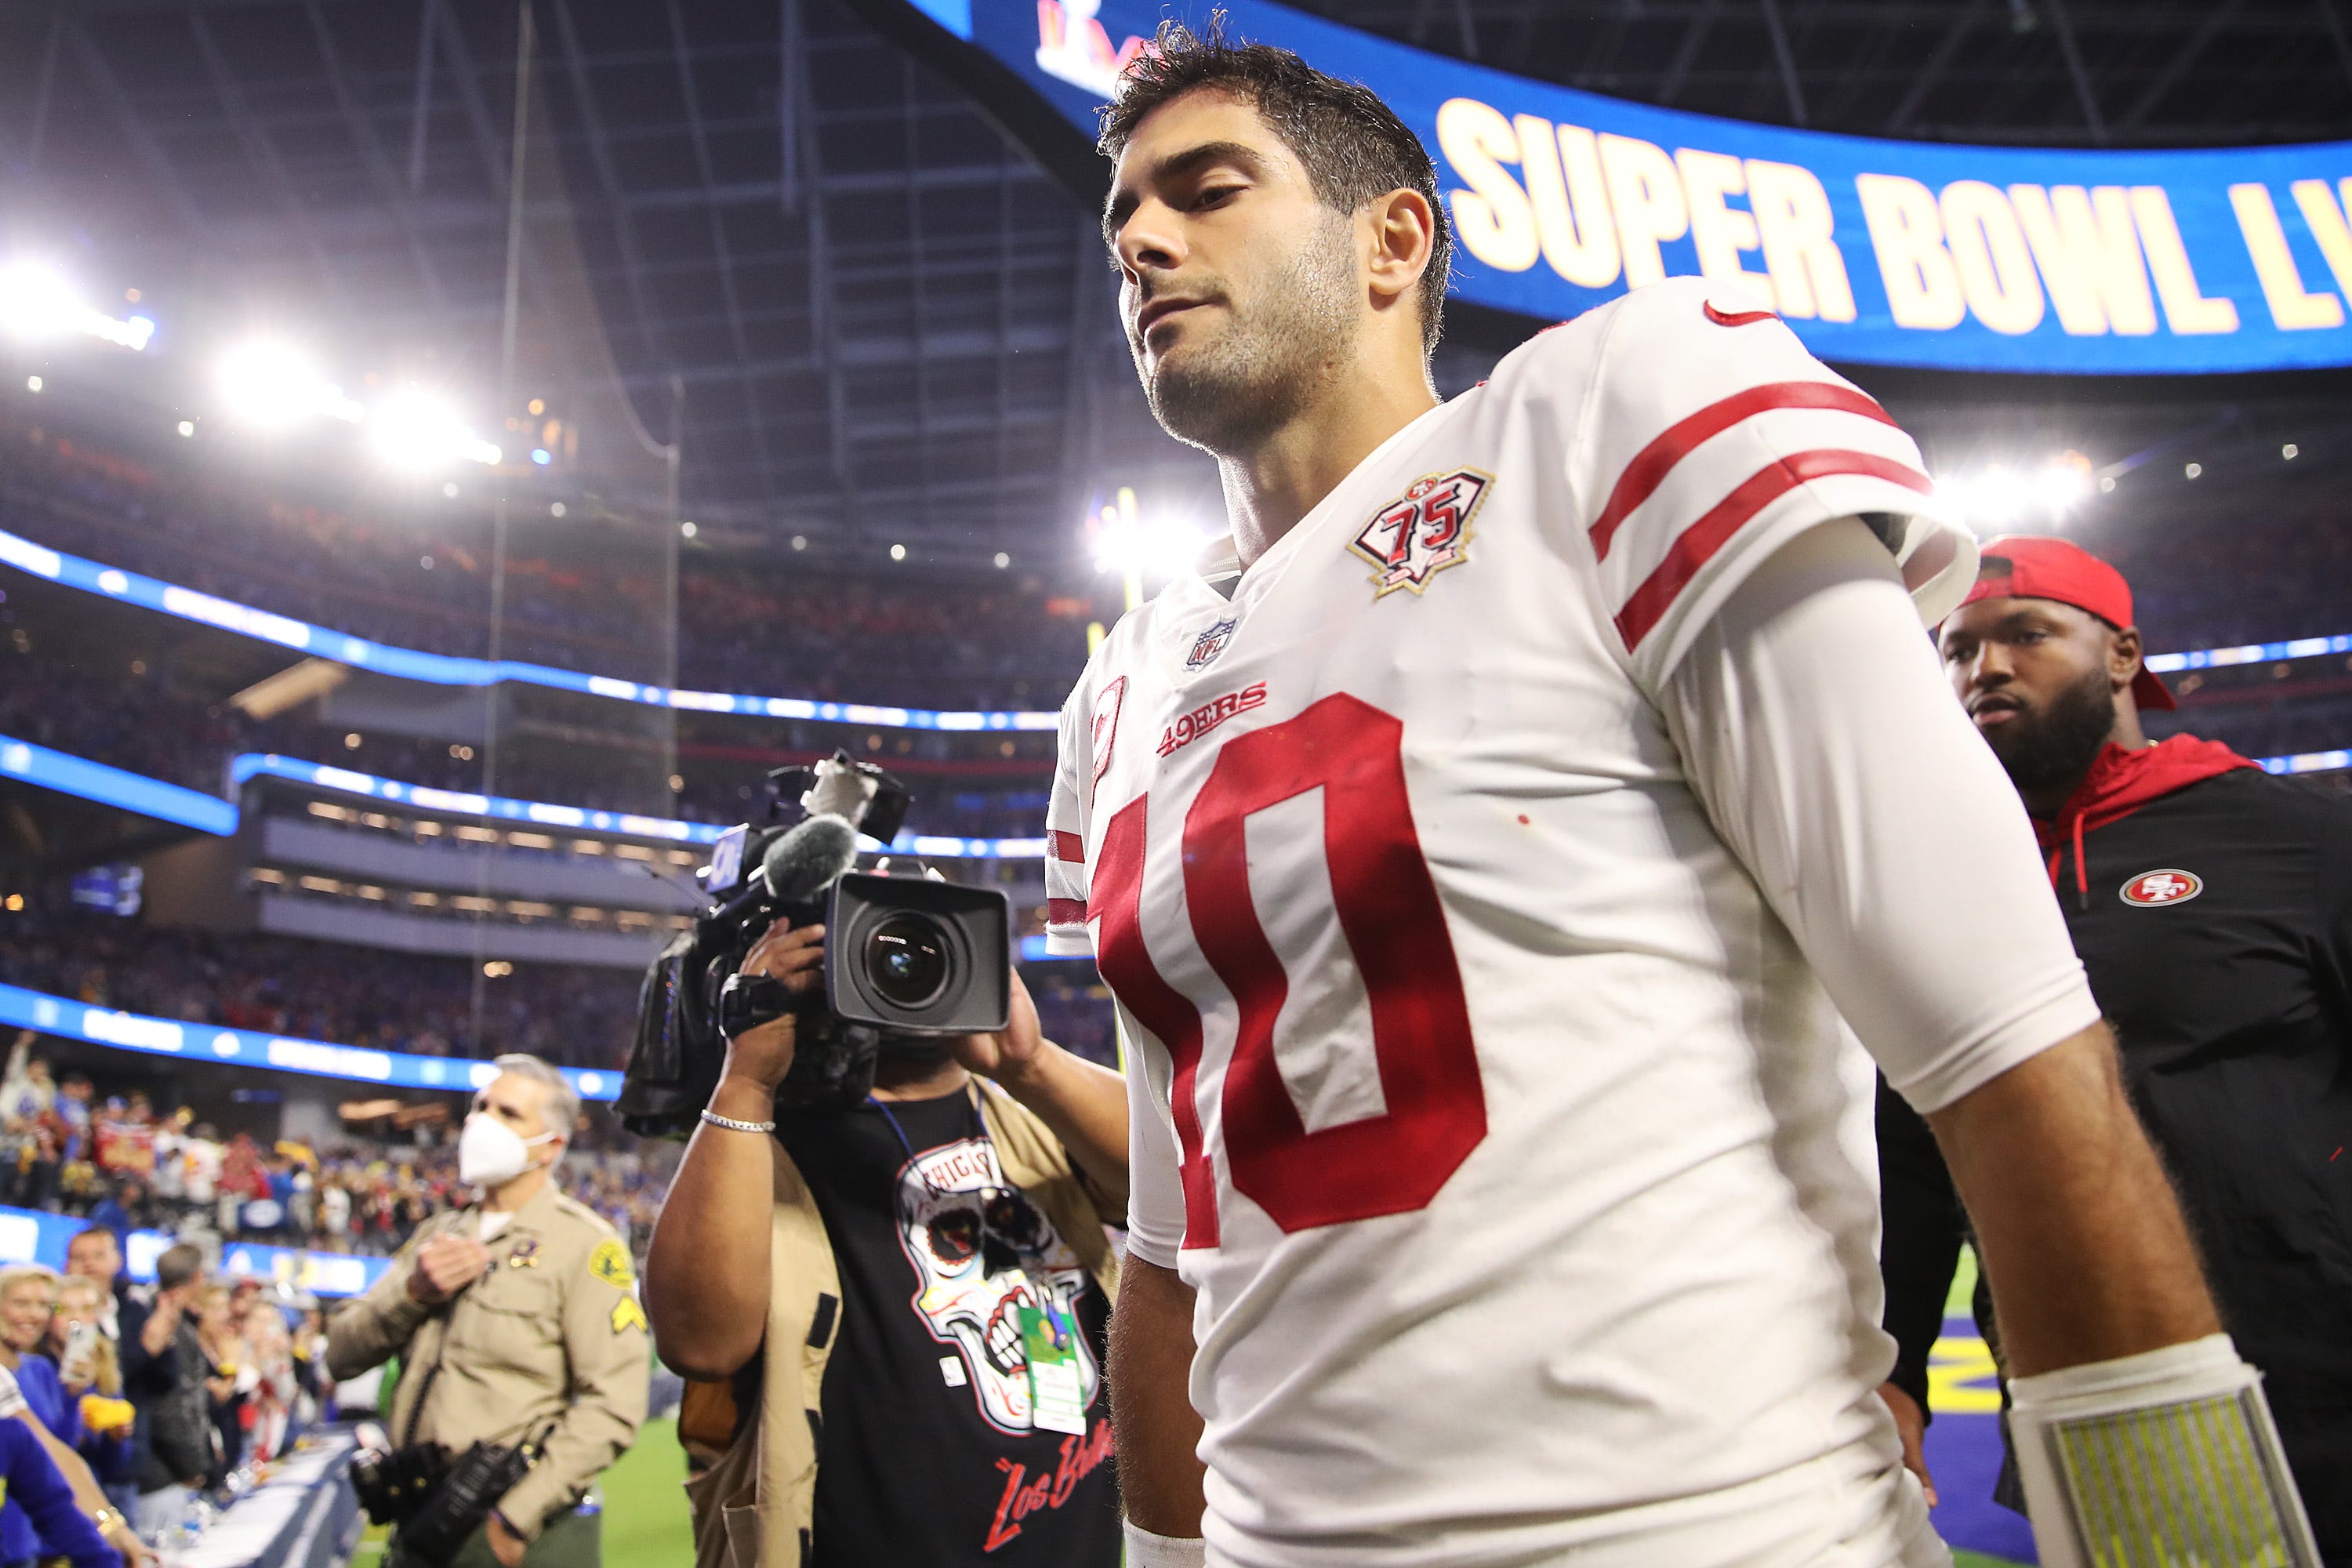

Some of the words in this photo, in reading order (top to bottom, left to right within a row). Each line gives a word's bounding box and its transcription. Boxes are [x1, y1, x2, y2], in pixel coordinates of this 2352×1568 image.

[1436, 96, 1857, 324] SUPER
[1856, 172, 2239, 336] BOWL
[1383, 487, 1457, 568] 75
[1191, 637, 1224, 662] NFL
[1156, 681, 1267, 758] 49ERS
[1086, 691, 1488, 1250] 10
